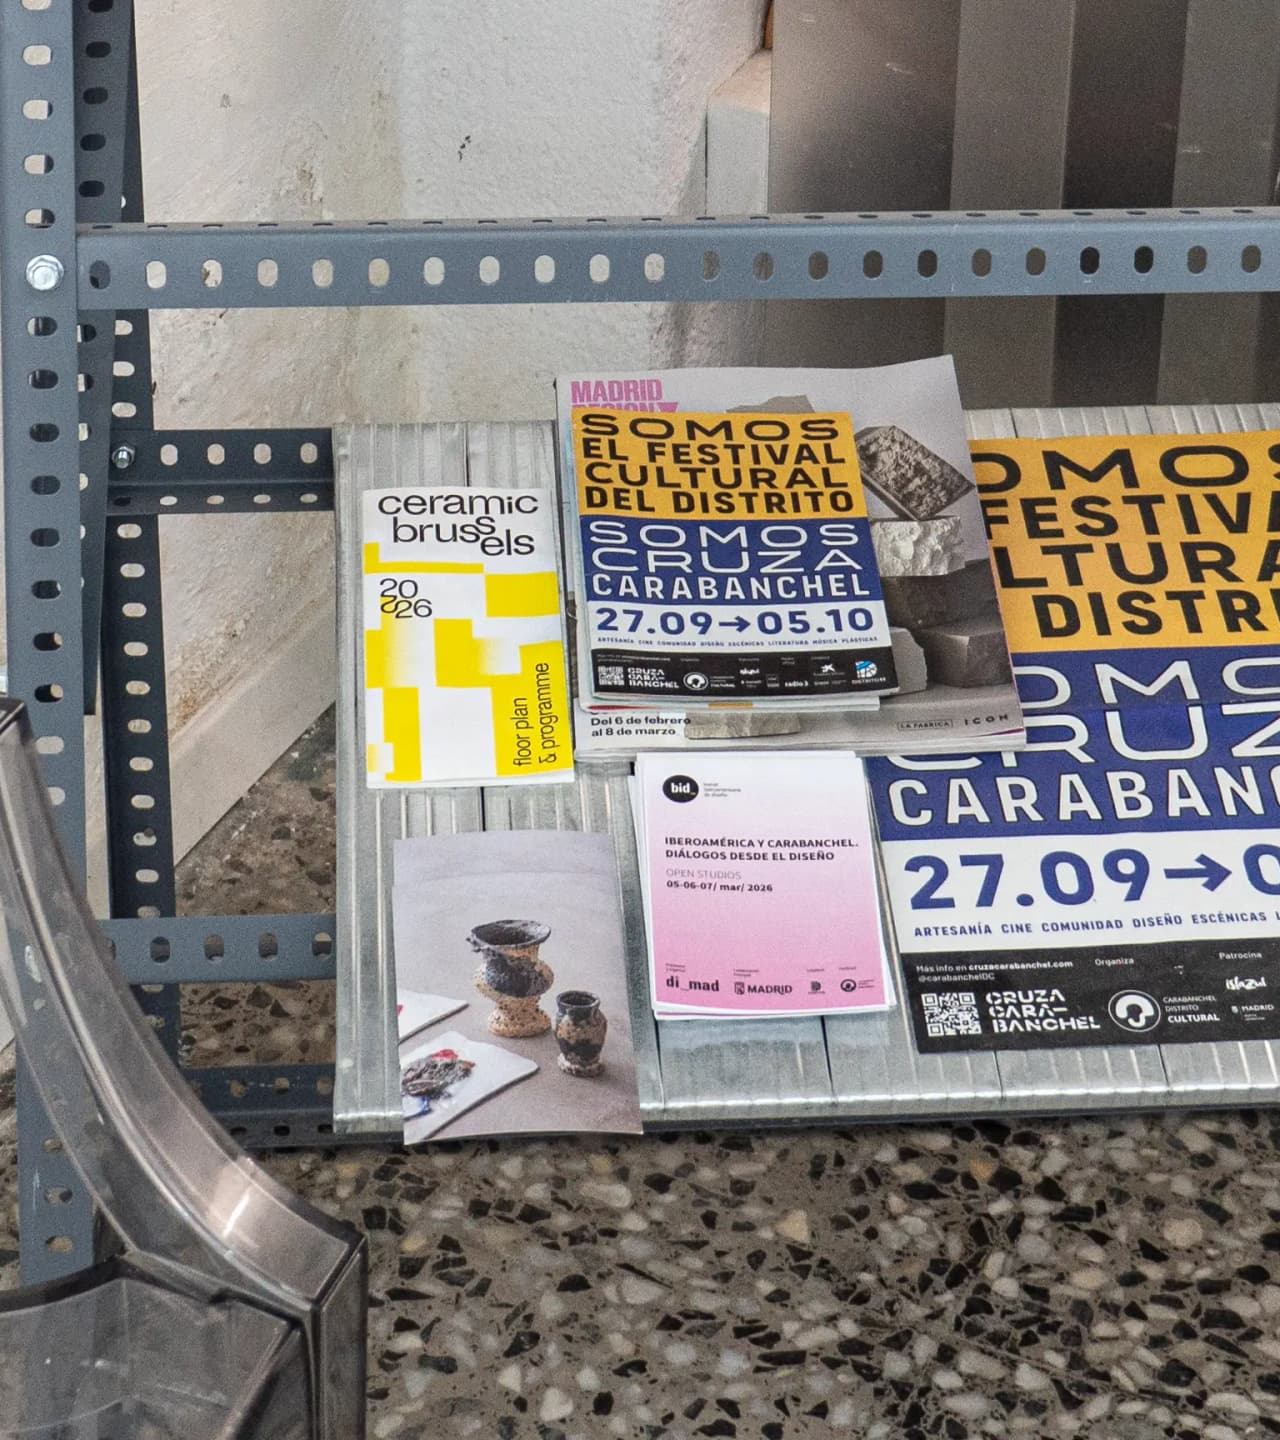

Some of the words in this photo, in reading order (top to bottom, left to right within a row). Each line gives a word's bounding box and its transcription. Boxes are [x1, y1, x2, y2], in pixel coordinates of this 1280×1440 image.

[571, 379, 663, 403] MADRID
[581, 413, 838, 441] SOMOS
[582, 437, 628, 461] EL
[647, 441, 846, 465] FESTIVAL
[585, 461, 848, 489] CULTURAL
[378, 494, 539, 515] ceramic
[585, 486, 655, 512] DEL
[672, 490, 854, 514] DISTRITO
[393, 515, 535, 556] brussels
[589, 521, 859, 548] SOMOS
[592, 547, 863, 574] CRUZA
[592, 573, 870, 600] CARABANCHEL
[629, 680, 679, 689] BANCHEL
[535, 663, 560, 750] programme
[510, 697, 534, 730] plan
[964, 714, 1008, 726] ICON
[591, 717, 612, 726] Del
[615, 716, 624, 725] 6
[625, 716, 642, 725] de
[645, 716, 691, 725] febrero
[591, 728, 603, 737] al
[605, 728, 614, 736] 8
[616, 727, 632, 735] de
[513, 734, 532, 766] floor
[539, 753, 557, 764] &
[665, 836, 755, 848] IBEROAMÉRICA
[757, 840, 764, 848] Y
[767, 839, 859, 848] CARABANCHEL.
[665, 849, 727, 860] DIÁLOGOS
[730, 852, 769, 861] DESDE
[772, 852, 786, 861] EL
[789, 850, 835, 861] DISEÑO
[666, 869, 695, 878] OPEN
[697, 870, 742, 880] STUDIOS
[747, 884, 773, 892] 2026
[914, 921, 992, 937] ARTESANÍA
[1001, 923, 1032, 934] CINE
[1042, 919, 1123, 932] COMUNIDAD
[1132, 912, 1183, 928] DISEÑO
[1192, 910, 1267, 925] ESCÉNICAS
[1219, 951, 1262, 960] Patrocina
[916, 965, 935, 973] Más
[936, 963, 954, 972] info
[968, 960, 1073, 971] cruzacarabanchel.com
[1095, 957, 1134, 968] Organiza
[747, 984, 793, 996] MADRID
[985, 988, 1065, 1005] CRUZA
[1162, 995, 1217, 1003] CARABANCHEL
[1165, 1004, 1199, 1012] DISTRITO
[1241, 1004, 1274, 1012] MADRID
[992, 1015, 1101, 1033] BANCHEL
[1167, 1013, 1220, 1024] CULTURAL
